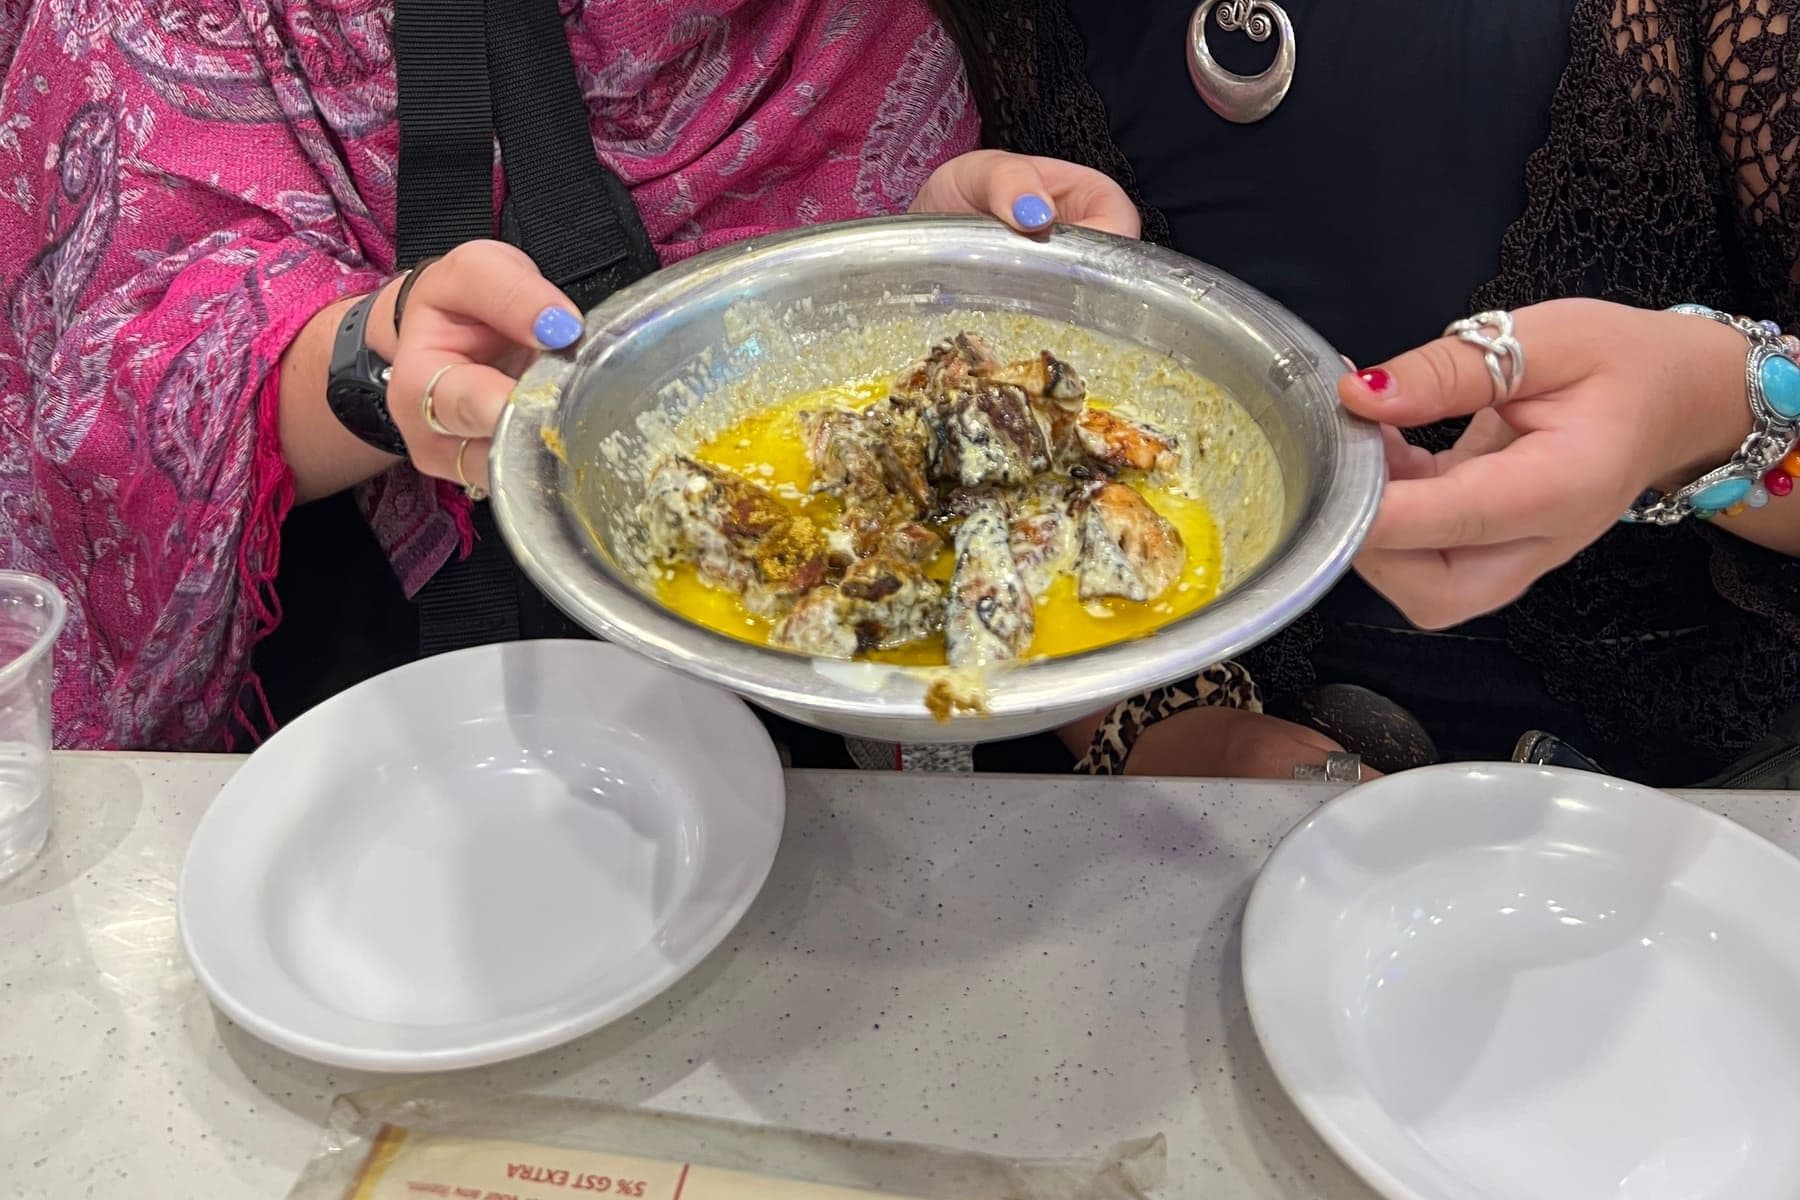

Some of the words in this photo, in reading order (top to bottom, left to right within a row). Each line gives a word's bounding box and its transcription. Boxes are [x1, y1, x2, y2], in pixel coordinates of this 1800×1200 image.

[506, 1162, 570, 1186] EXTRA
[570, 1173, 612, 1192] GST
[615, 1178, 648, 1197] 5%
